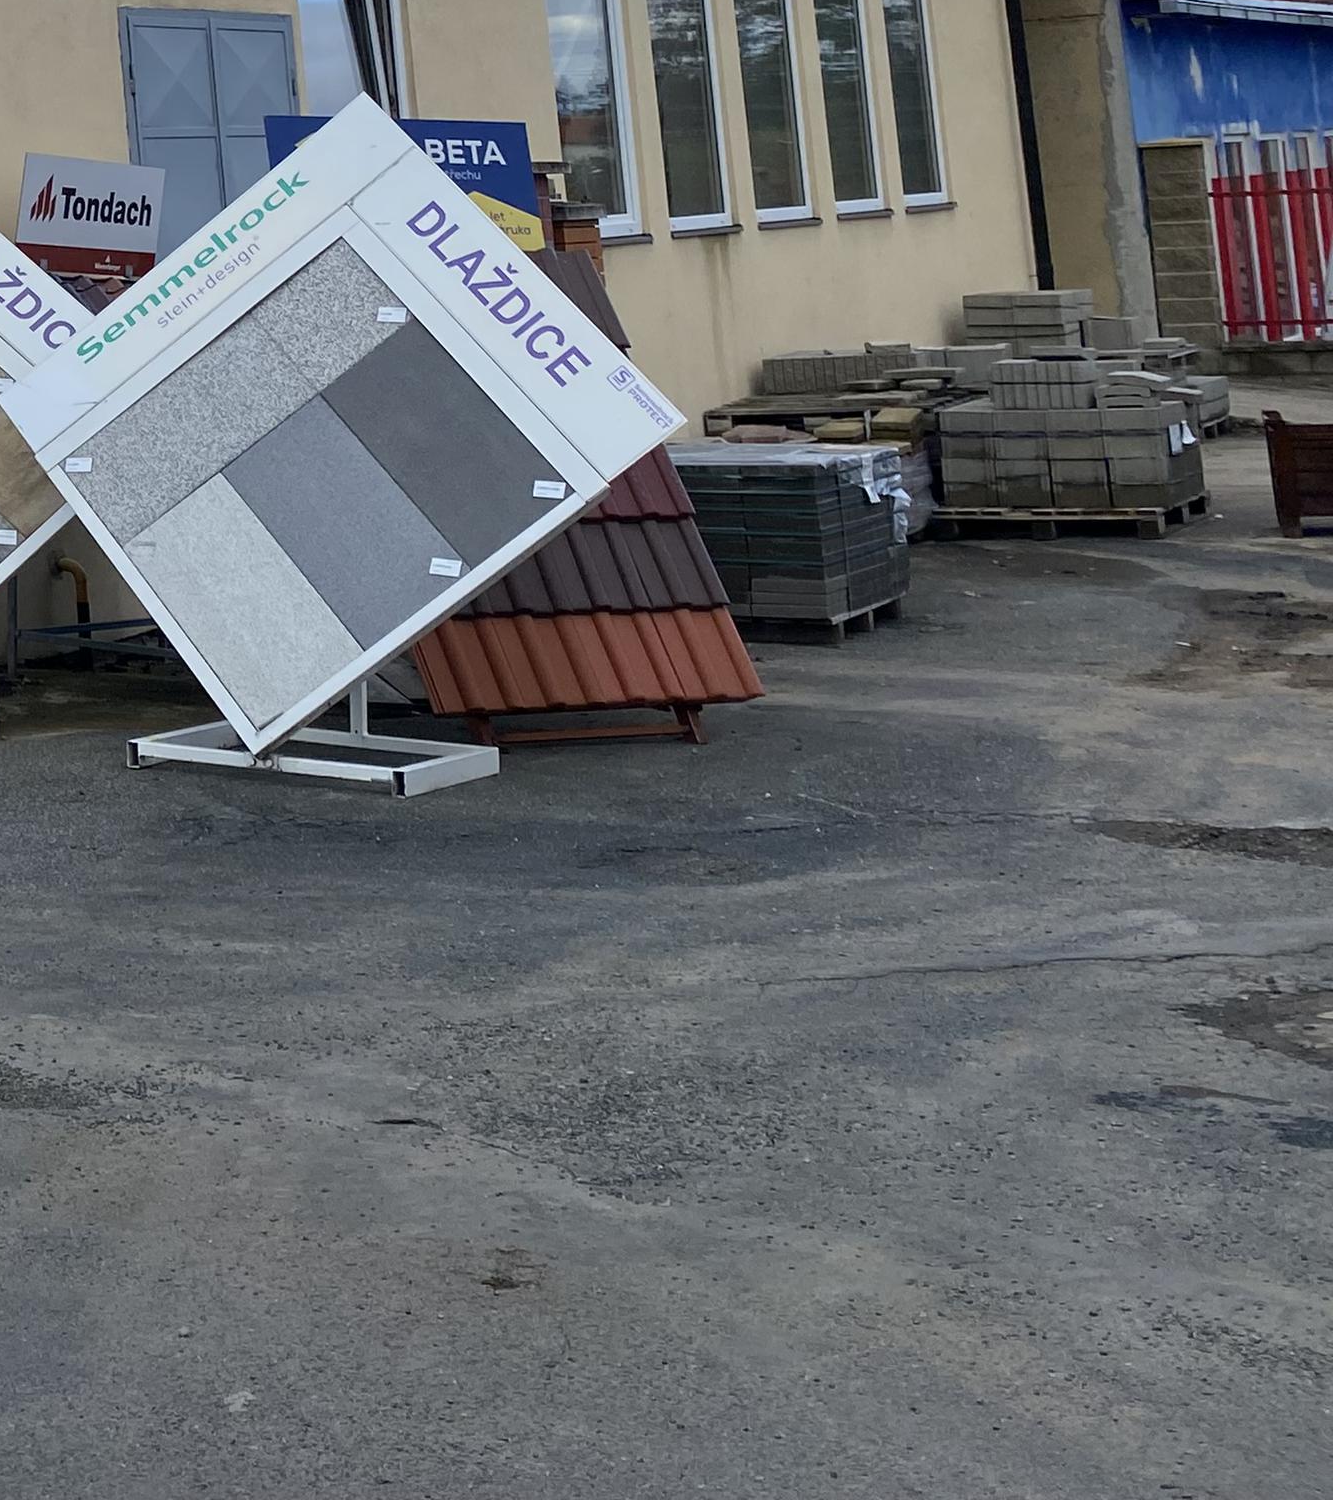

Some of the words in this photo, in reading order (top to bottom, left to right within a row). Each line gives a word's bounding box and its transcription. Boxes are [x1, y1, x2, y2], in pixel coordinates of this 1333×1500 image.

[424, 138, 508, 166] BETA
[444, 168, 483, 181] řechu
[61, 186, 152, 227] Tondach
[500, 223, 532, 236] ruka
[76, 171, 310, 365] Semmelrock
[406, 200, 592, 388] DLAŽDICE
[627, 388, 670, 429] PROTECT
